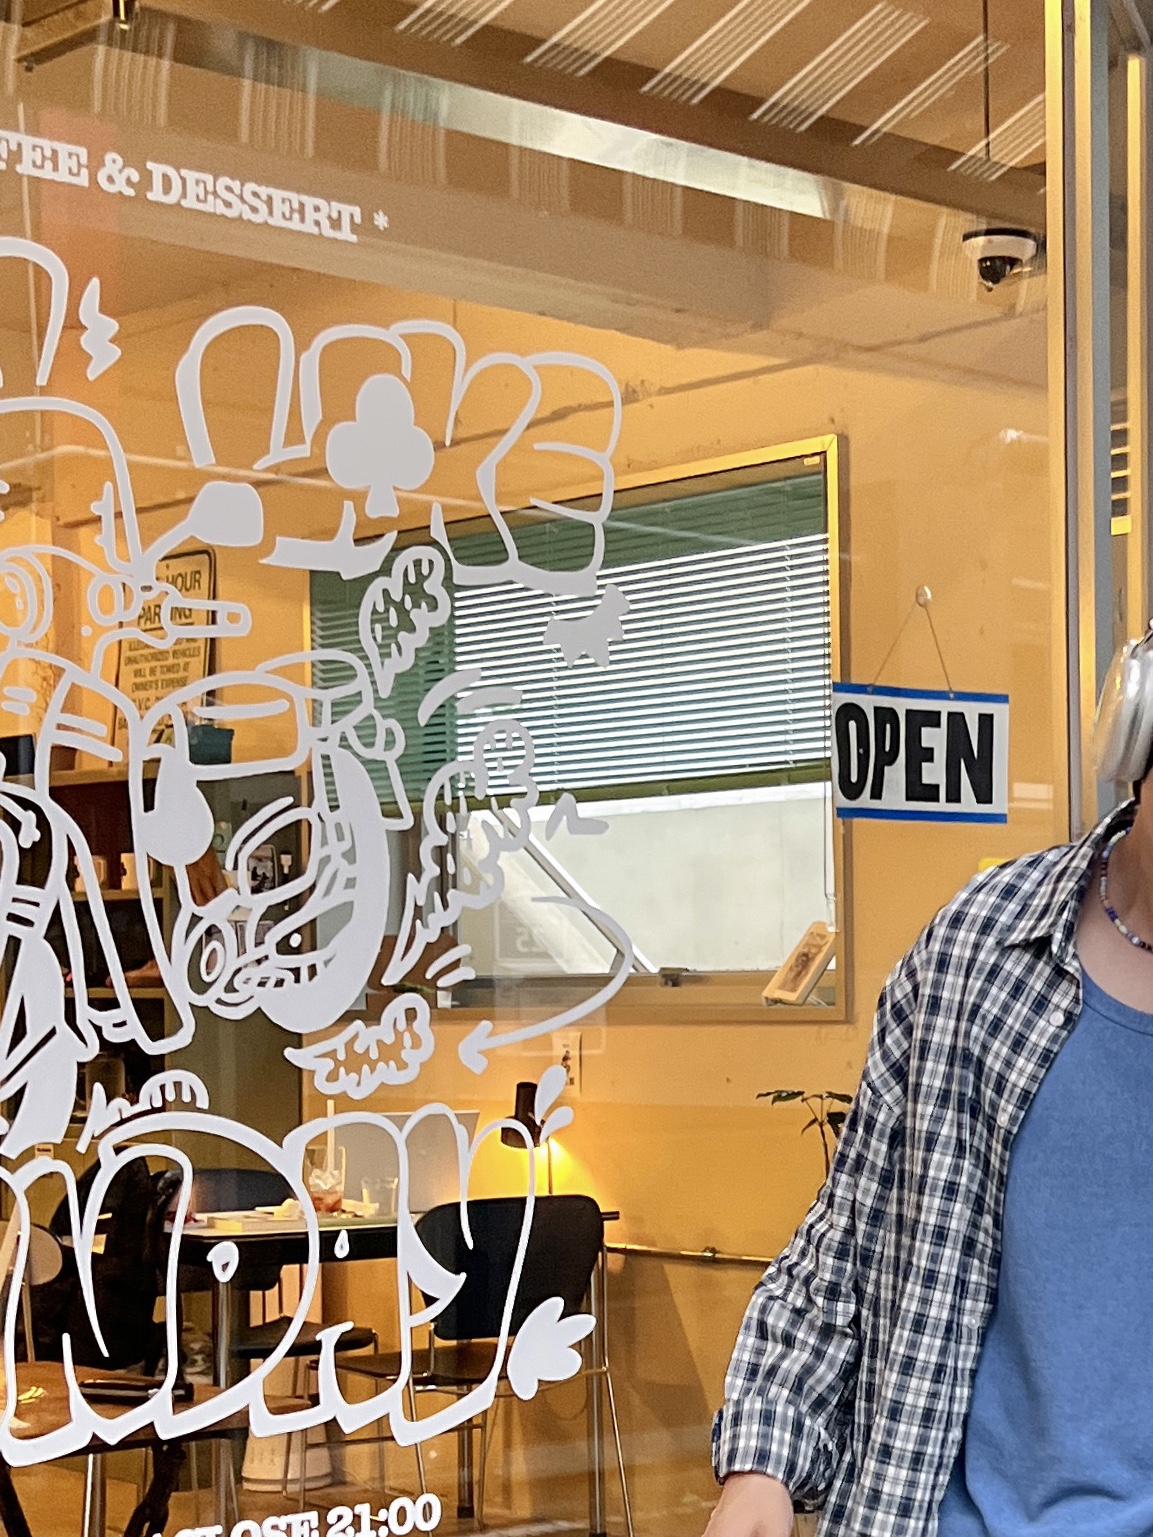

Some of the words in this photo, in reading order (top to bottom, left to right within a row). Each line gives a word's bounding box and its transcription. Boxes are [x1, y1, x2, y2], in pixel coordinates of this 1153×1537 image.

[96, 151, 140, 197] &
[145, 161, 362, 243] DESSERT
[138, 605, 193, 627] PARING
[835, 702, 994, 804] OPEN
